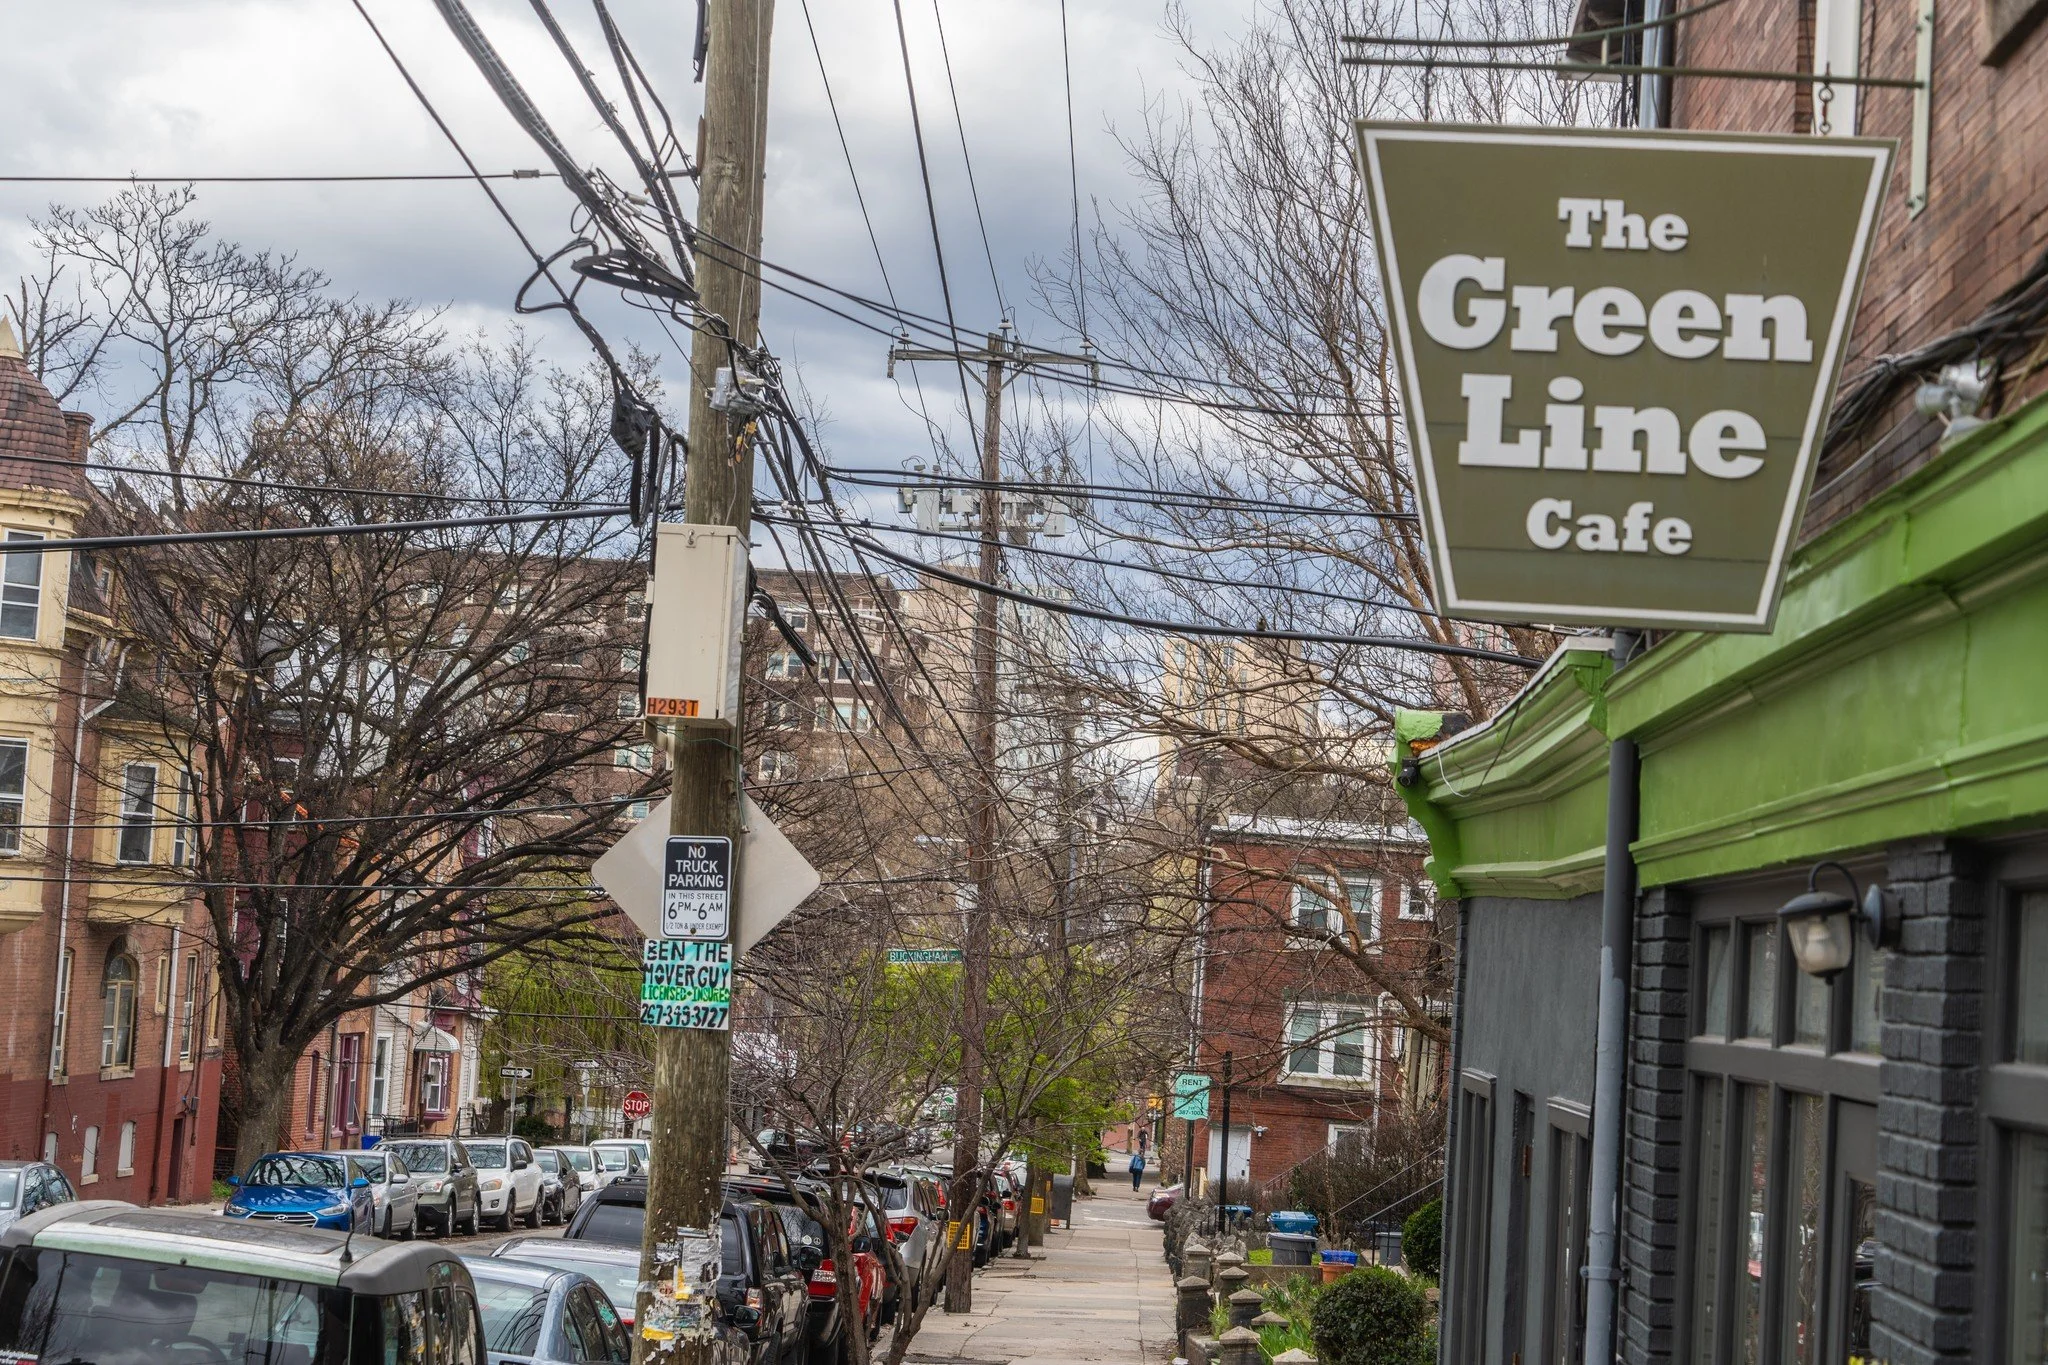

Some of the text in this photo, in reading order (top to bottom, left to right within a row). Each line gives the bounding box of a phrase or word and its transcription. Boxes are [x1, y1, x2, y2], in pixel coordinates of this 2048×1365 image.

[1557, 197, 1689, 251] The
[1417, 253, 1813, 363] Green
[1458, 373, 1767, 480] Line
[1526, 497, 1693, 556] Cafe
[647, 698, 699, 717] H293T
[688, 846, 706, 858] NO
[676, 860, 718, 873] TRUCK
[669, 875, 724, 888] PARKING
[647, 940, 729, 963] BEN THE
[889, 951, 948, 962] BUCKINGHAM
[643, 963, 729, 989] MOVER GUY
[625, 1101, 650, 1112] STOP
